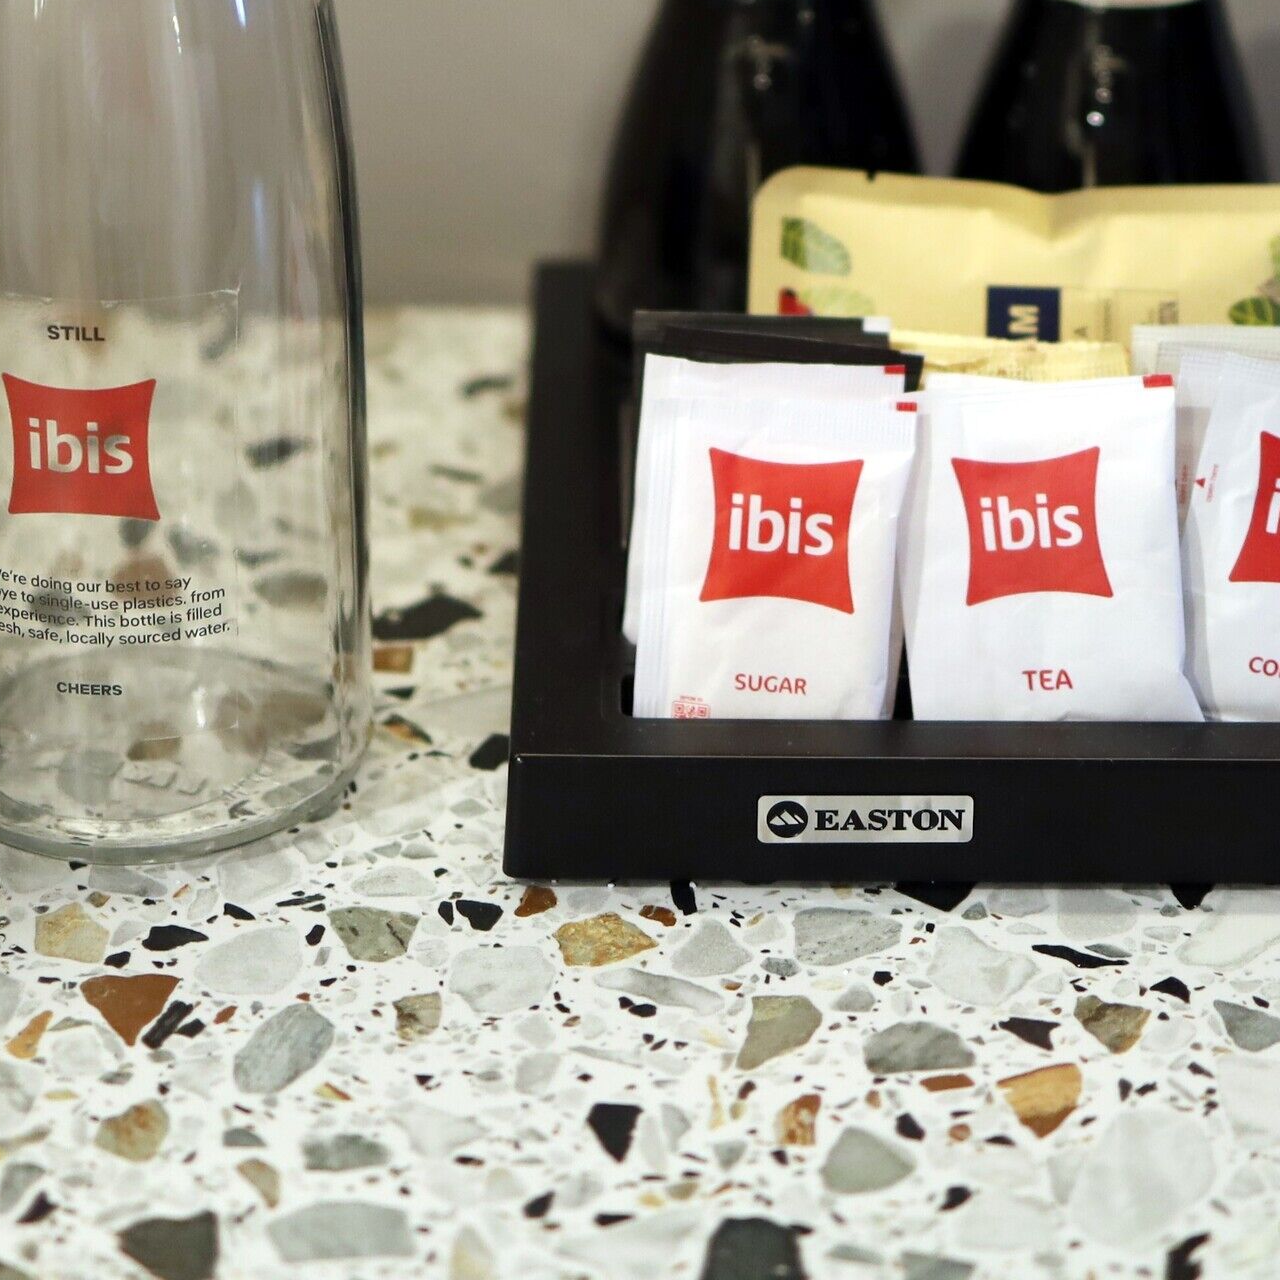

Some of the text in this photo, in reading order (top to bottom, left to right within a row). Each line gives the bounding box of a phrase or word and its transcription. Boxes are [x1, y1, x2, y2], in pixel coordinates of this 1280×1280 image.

[47, 325, 105, 341] STILL
[28, 417, 134, 474] ibis
[728, 493, 834, 557] ibis
[980, 493, 1084, 552] ibis
[31, 575, 72, 594] doing
[76, 582, 101, 593] our
[105, 580, 140, 593] best
[145, 580, 160, 591] to
[165, 577, 192, 590] say
[21, 591, 35, 604] to
[39, 595, 119, 611] single-use
[191, 588, 225, 603] from
[83, 615, 116, 627] This
[120, 613, 166, 627] bottle
[170, 611, 182, 624] is
[186, 603, 222, 621] filled
[28, 627, 62, 643] safe,
[66, 630, 114, 648] locally
[119, 628, 181, 645] sourced
[185, 621, 230, 639] water.
[57, 681, 123, 696] CHEERS
[734, 673, 807, 695] SUGAR
[1022, 669, 1073, 691] TEA
[814, 809, 966, 831] EASTON
